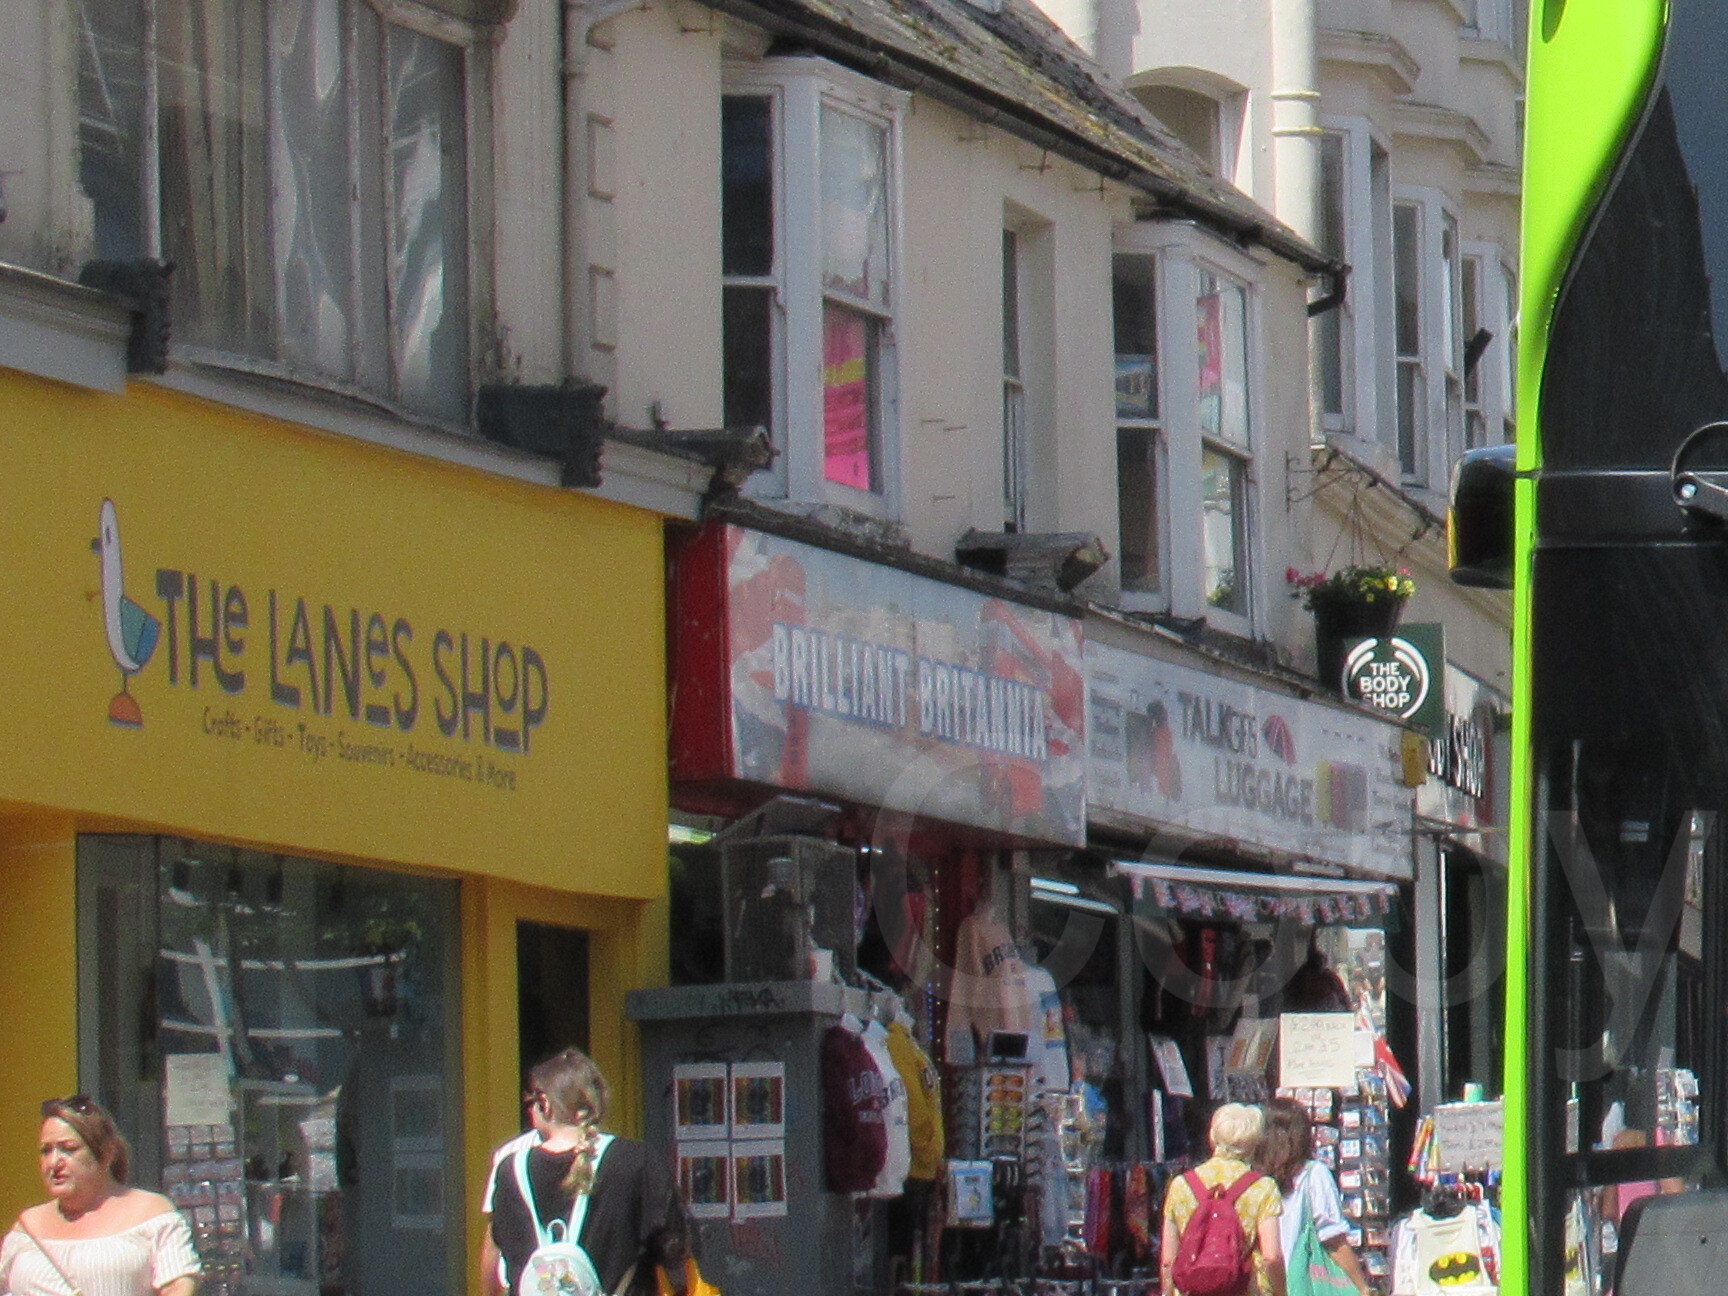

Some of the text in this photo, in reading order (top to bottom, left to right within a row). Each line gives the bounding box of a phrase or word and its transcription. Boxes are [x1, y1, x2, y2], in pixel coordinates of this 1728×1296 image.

[774, 620, 912, 734] BRILLIANT
[918, 656, 1050, 762] BRITANNIA
[1359, 675, 1411, 693] BODY
[1369, 662, 1400, 676] THE
[1214, 755, 1314, 826] LUGGAGE
